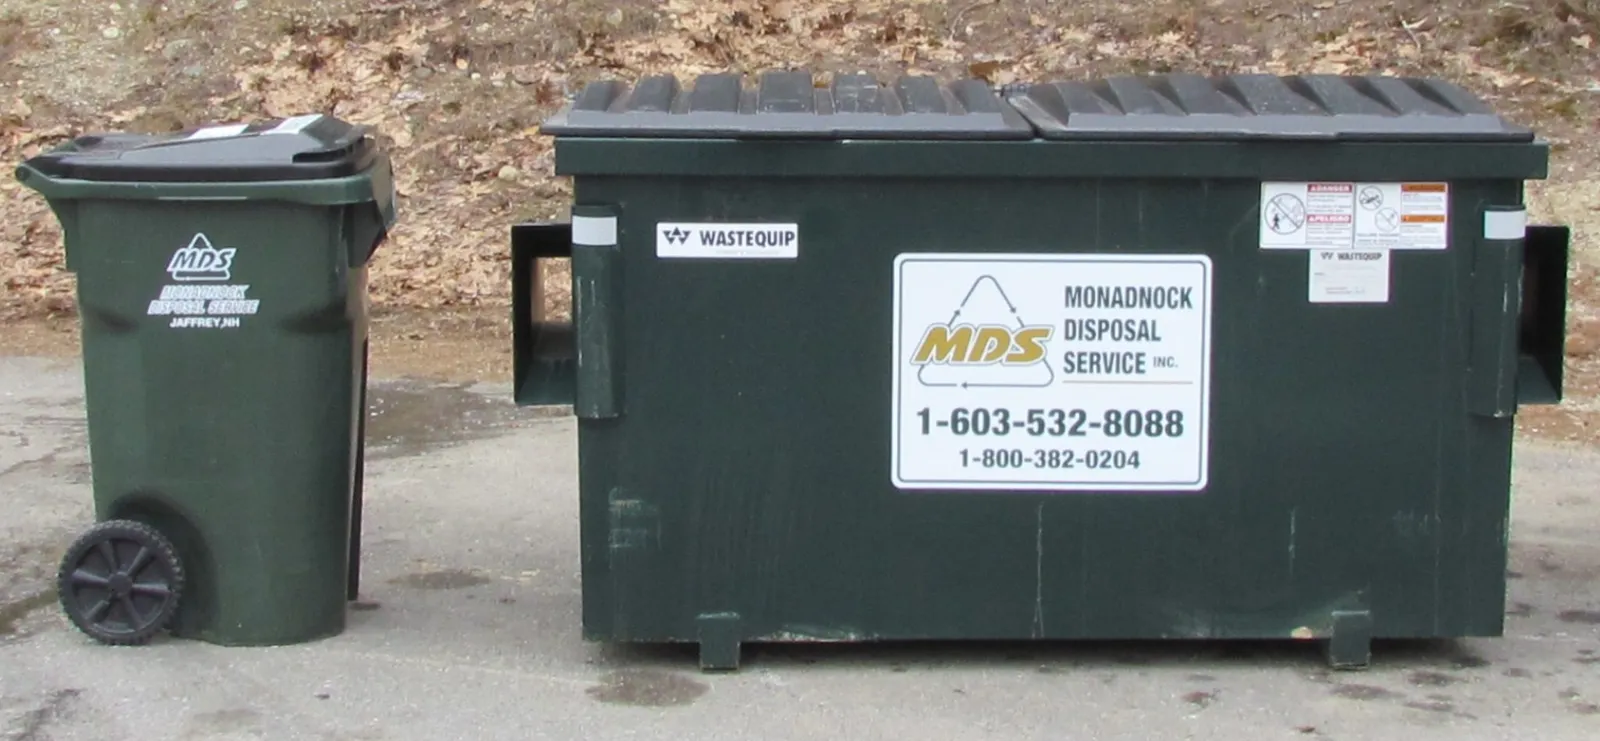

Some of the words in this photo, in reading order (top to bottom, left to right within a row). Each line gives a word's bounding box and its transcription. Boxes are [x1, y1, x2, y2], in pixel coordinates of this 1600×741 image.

[700, 230, 796, 248] WASTEQUIP
[167, 247, 236, 272] MDS
[1338, 252, 1382, 261] WASTEQUIP
[147, 300, 206, 314] DISPOSAL
[207, 300, 260, 314] SERVICE
[1064, 286, 1193, 309] MONADNOCK
[1064, 319, 1161, 342] DISPOSAL
[910, 323, 1055, 366] MDS
[1063, 351, 1146, 374] SERVICE
[1153, 356, 1179, 369] INC.
[916, 407, 1184, 438] 1-603-532-8088
[959, 449, 1140, 469] 1-800-382-0204
